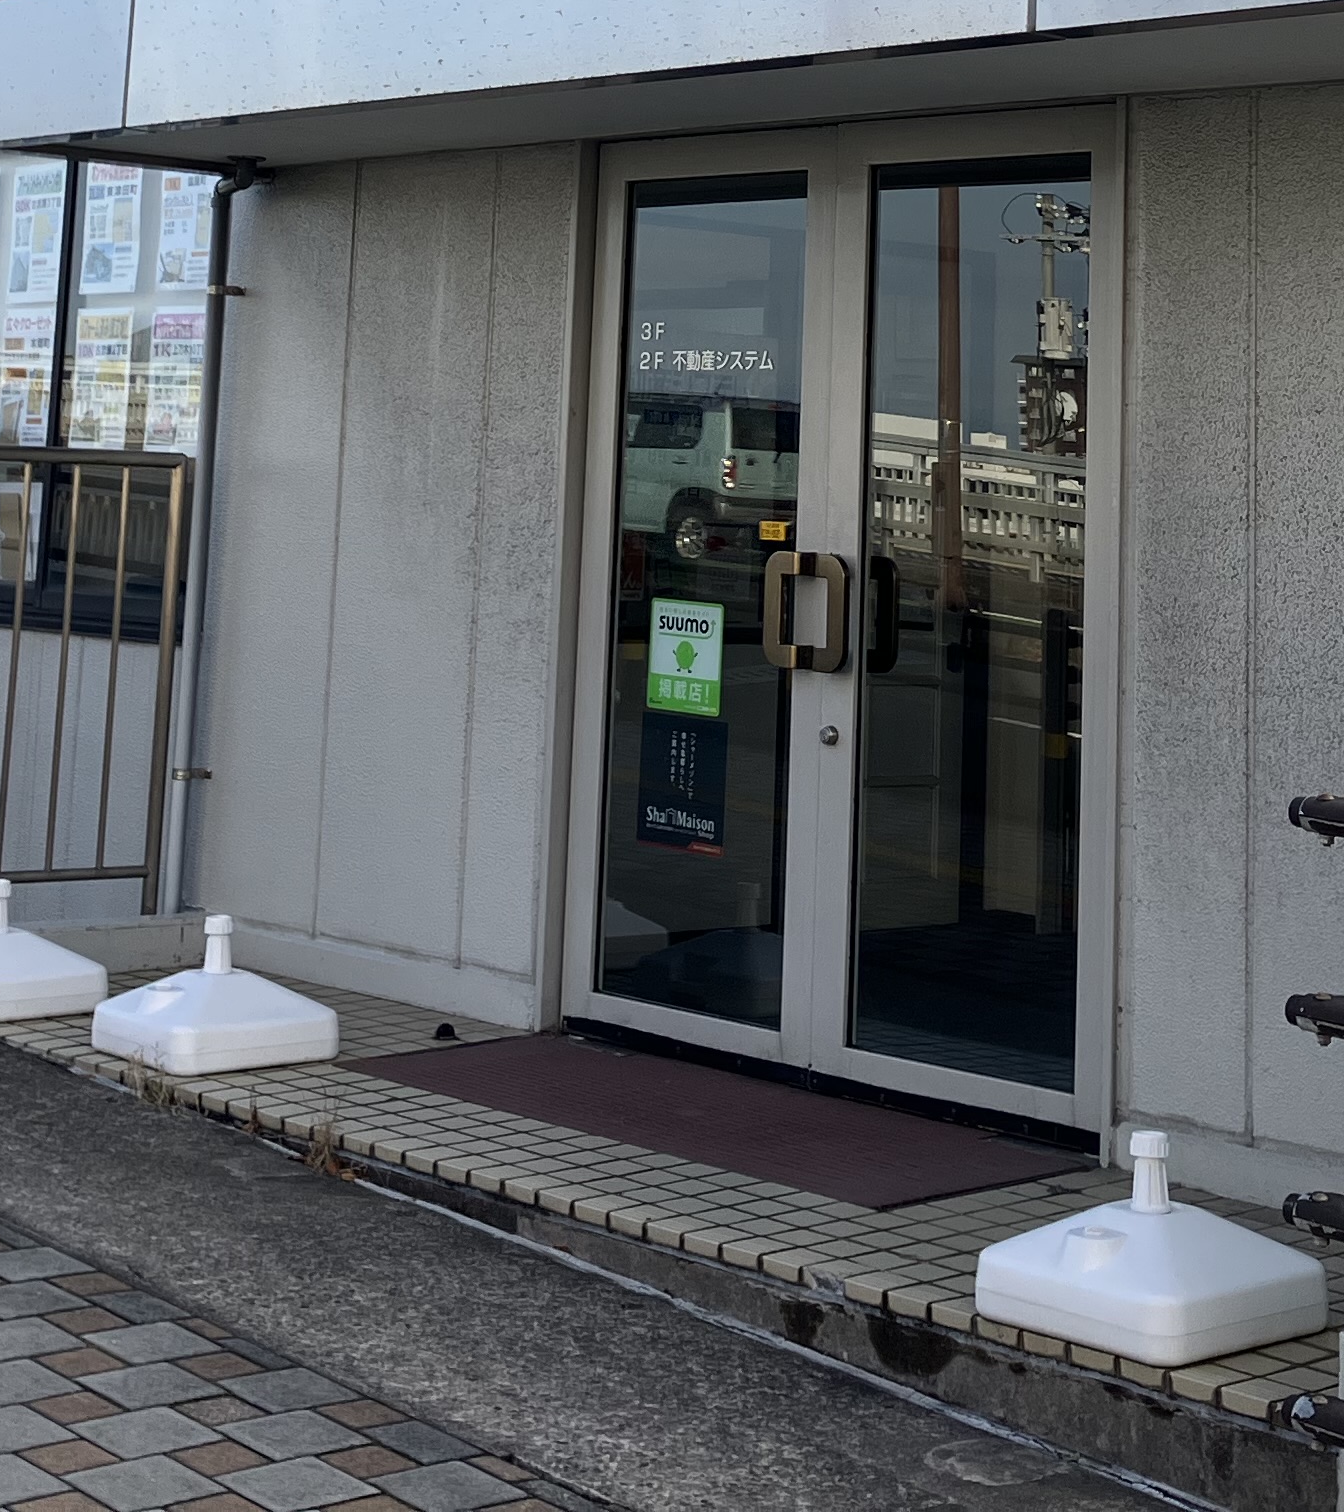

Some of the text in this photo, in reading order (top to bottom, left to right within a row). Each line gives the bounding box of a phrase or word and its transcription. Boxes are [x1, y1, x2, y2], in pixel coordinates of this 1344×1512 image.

[672, 349, 774, 372] 不動産システム
